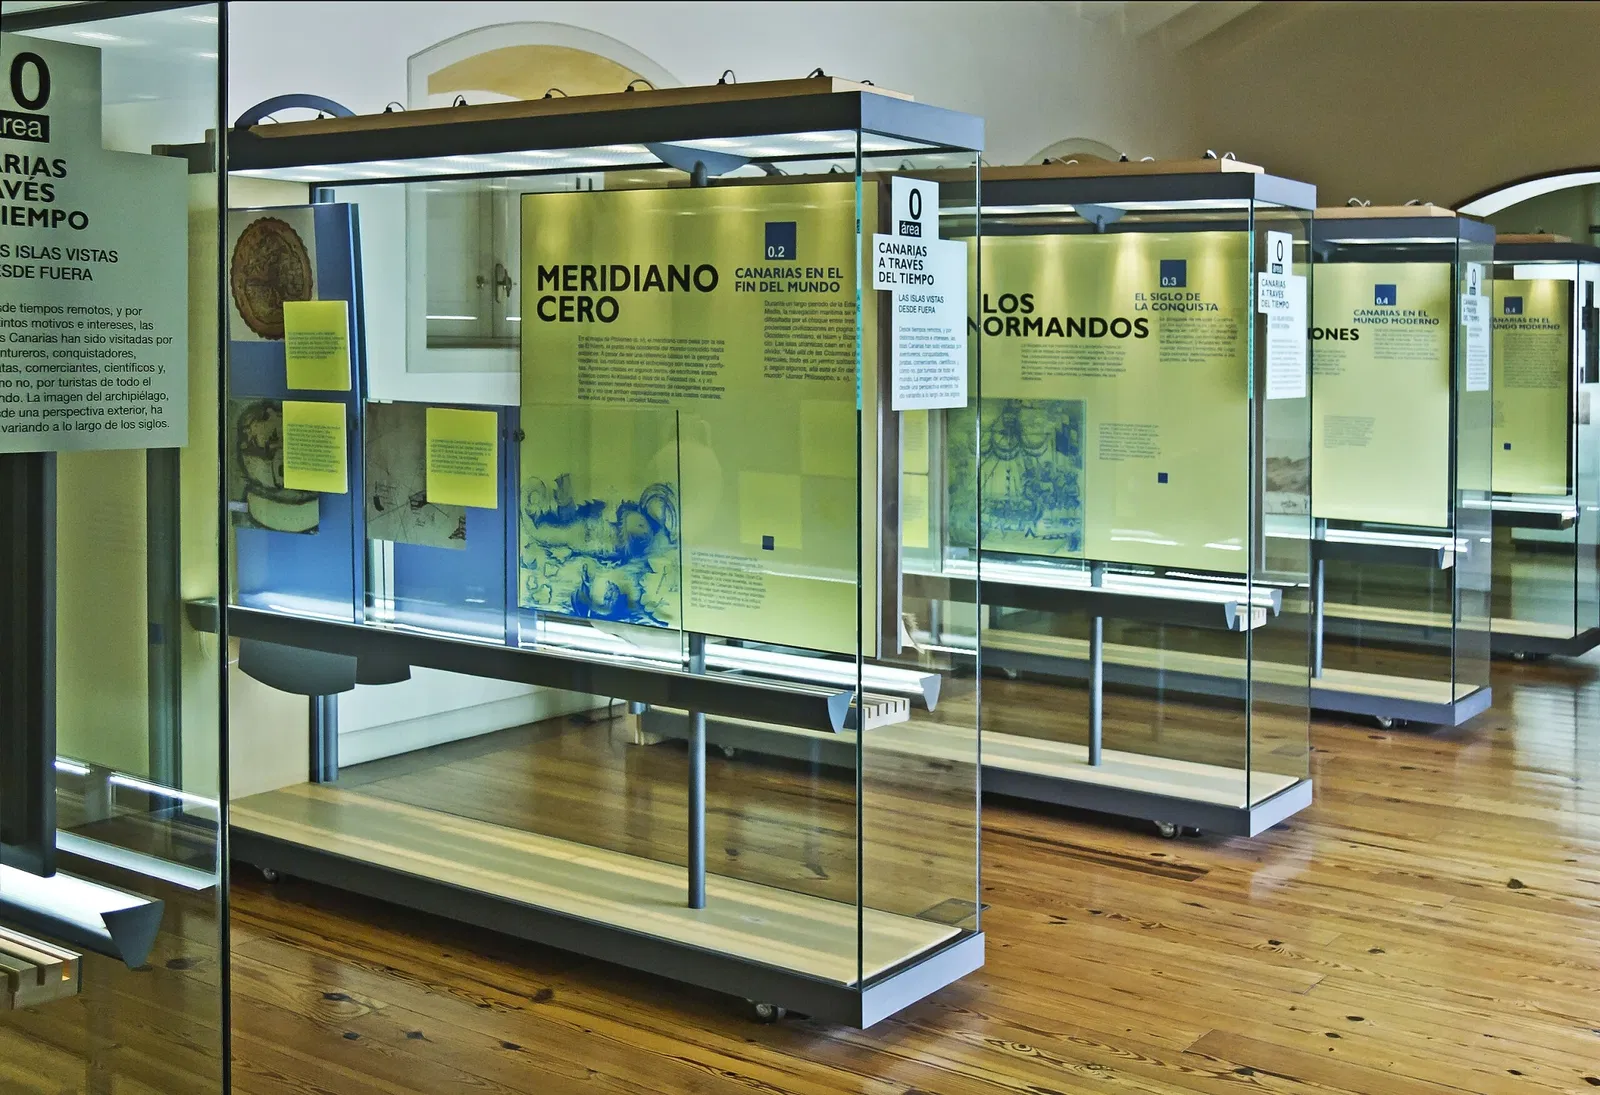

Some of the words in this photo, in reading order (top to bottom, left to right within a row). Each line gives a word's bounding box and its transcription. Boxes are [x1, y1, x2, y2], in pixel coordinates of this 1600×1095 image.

[10, 52, 50, 110] 0
[0, 117, 42, 138] rea
[0, 153, 67, 178] RIAS
[0, 177, 55, 202] VÉS
[909, 188, 922, 220] 0
[901, 222, 919, 235] área
[16, 245, 61, 260] ISLAS
[66, 248, 118, 263] VISTAS
[768, 246, 784, 257] 0.2
[879, 242, 927, 257] CANARIAS
[879, 257, 885, 268] A
[888, 254, 923, 270] TRAVÉS
[0, 265, 35, 279] SDE
[40, 267, 92, 281] FUERA
[538, 264, 719, 292] MERIDIANO
[735, 268, 801, 278] CANARIAS
[806, 268, 823, 278] EN
[828, 268, 843, 278] EL
[879, 272, 897, 283] DEL
[900, 273, 934, 285] TIEMPO
[735, 281, 755, 292] FIN
[760, 281, 784, 292] DEL
[788, 281, 840, 292] MUNDO
[1162, 277, 1177, 286] 0.3
[899, 294, 909, 302] LAS
[910, 295, 925, 303] ISLAS
[927, 295, 944, 303] VISTAS
[983, 293, 1034, 314] LOS
[1151, 293, 1182, 301] SIGLO
[1376, 297, 1388, 305] 0.4
[20, 303, 63, 315] tiempos
[67, 304, 113, 316] remotos,
[116, 307, 122, 317] y
[126, 307, 142, 317] por
[537, 295, 619, 323] CERO
[899, 305, 917, 313] DESDE
[918, 305, 935, 314] FUERA
[1152, 303, 1218, 312] CONQUISTA
[0, 318, 27, 328] intos
[32, 319, 74, 328] motivos
[87, 319, 136, 331] intereses,
[140, 321, 153, 330] las
[967, 317, 1149, 339] NORMANDOS
[9, 333, 58, 343] Canarias
[61, 333, 80, 343] han
[84, 334, 106, 343] sido
[109, 334, 153, 344] visitadas
[157, 337, 173, 346] por
[53, 348, 136, 360] conquistadores,
[0, 363, 21, 374] tas,
[26, 363, 100, 374] comerciantes,
[104, 363, 155, 373] científicos
[158, 364, 165, 375] y,
[16, 379, 33, 389] no,
[37, 379, 55, 389] por
[59, 377, 97, 387] turistas
[100, 377, 113, 387] de
[116, 377, 139, 387] todo
[143, 377, 151, 386] el
[27, 393, 40, 403] La
[44, 392, 82, 404] imagen
[86, 392, 101, 402] del
[105, 390, 169, 402] archipiélago,
[0, 408, 15, 418] de
[19, 409, 39, 418] una
[43, 406, 104, 419] perspectiva
[108, 405, 147, 416] exterior,
[151, 405, 162, 414] ha
[2, 422, 49, 433] variando
[53, 424, 59, 432] a
[63, 422, 72, 431] lo
[76, 421, 101, 432] largo
[105, 420, 117, 430] de
[121, 419, 135, 429] los
[139, 418, 169, 430] siglos.
